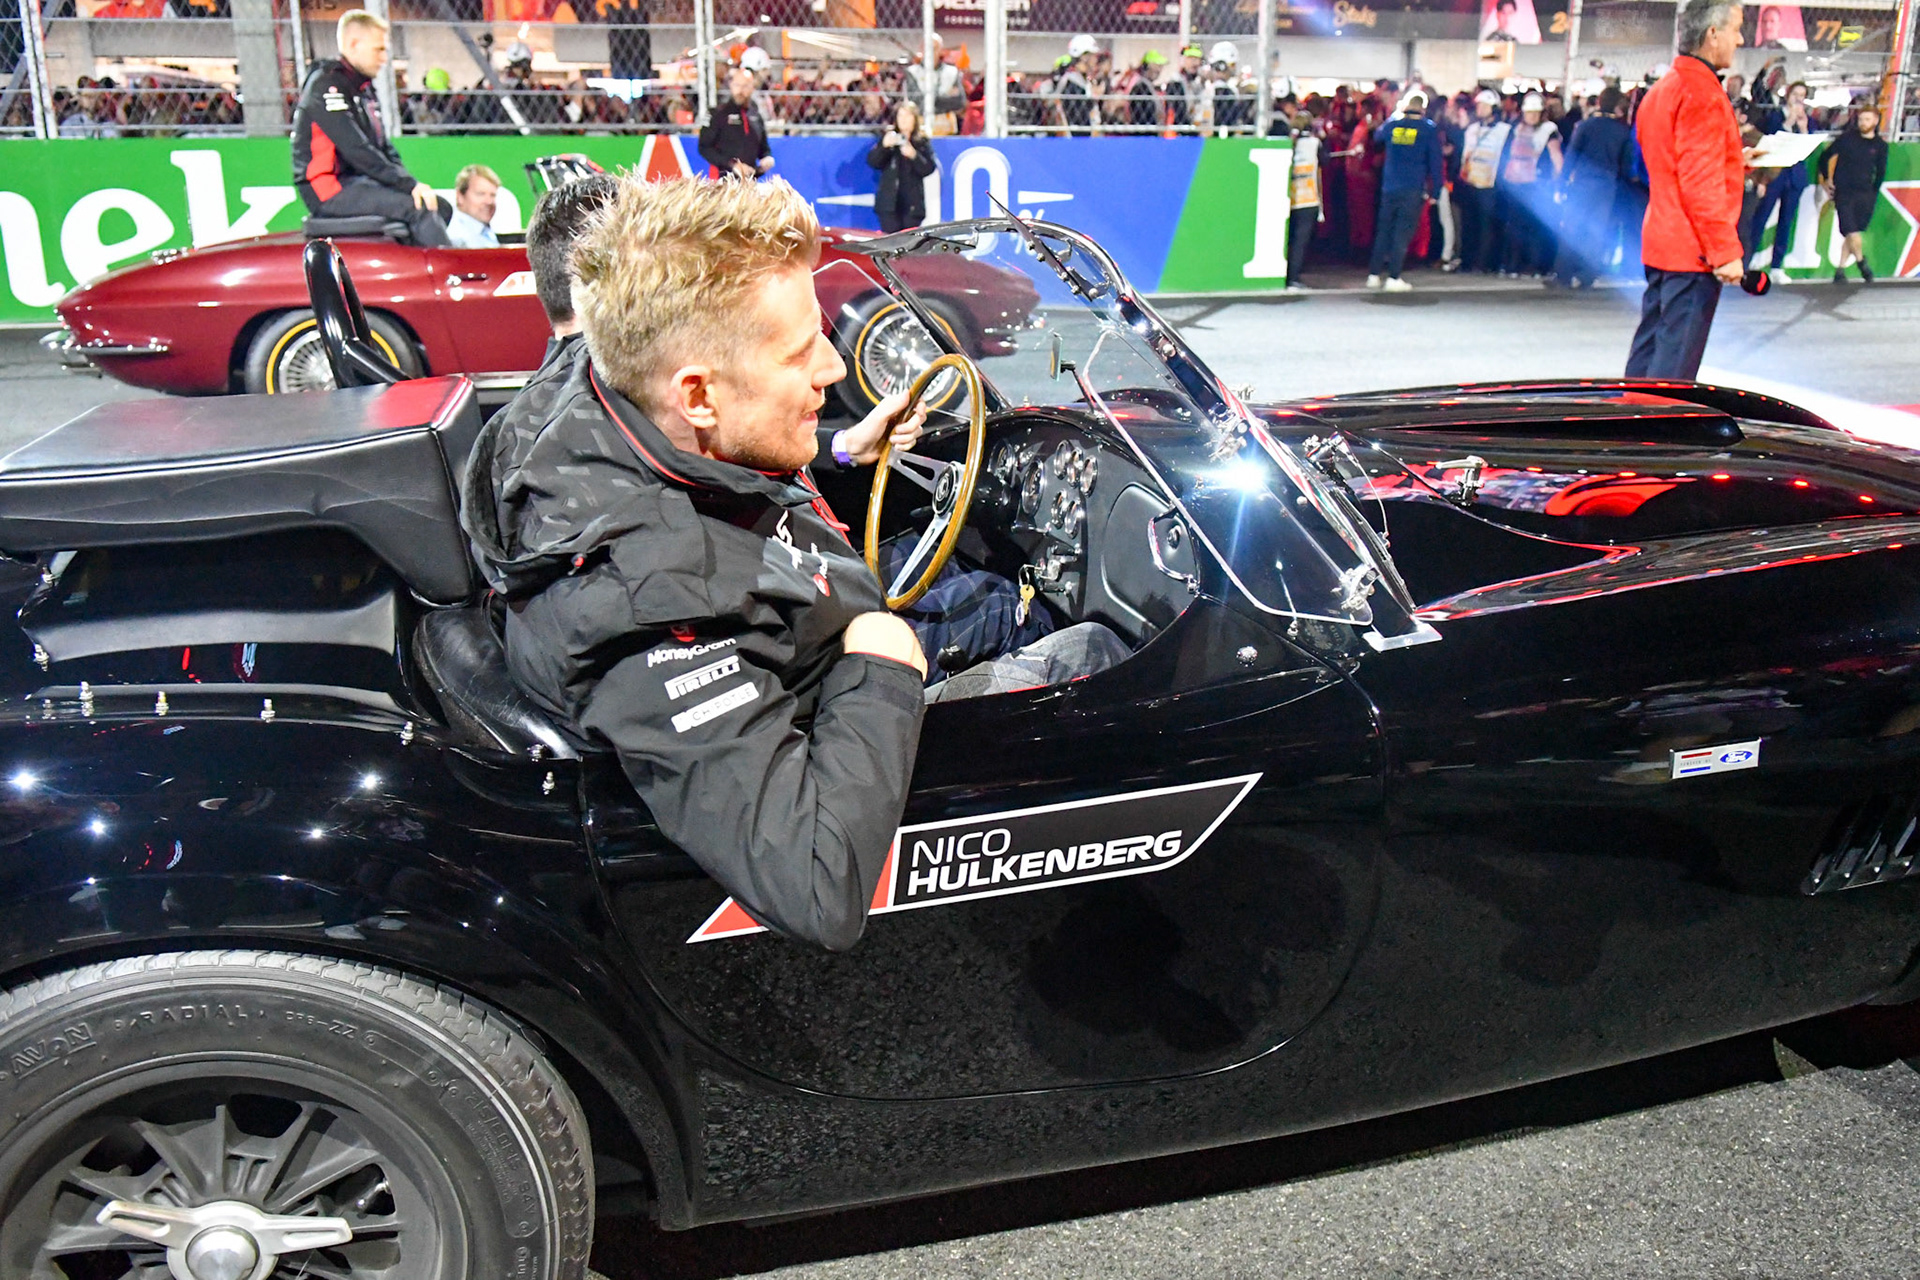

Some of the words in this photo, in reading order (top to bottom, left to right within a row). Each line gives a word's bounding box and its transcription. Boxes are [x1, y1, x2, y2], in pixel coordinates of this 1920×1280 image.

[1813, 20, 1843, 42] 77
[647, 638, 737, 668] MoneyGram
[664, 655, 741, 701] PIRELLI
[907, 829, 1182, 896] HULKENBERG
[911, 828, 1012, 868] NICO
[139, 1004, 248, 1026] RADIAL
[11, 1021, 94, 1075] AVON
